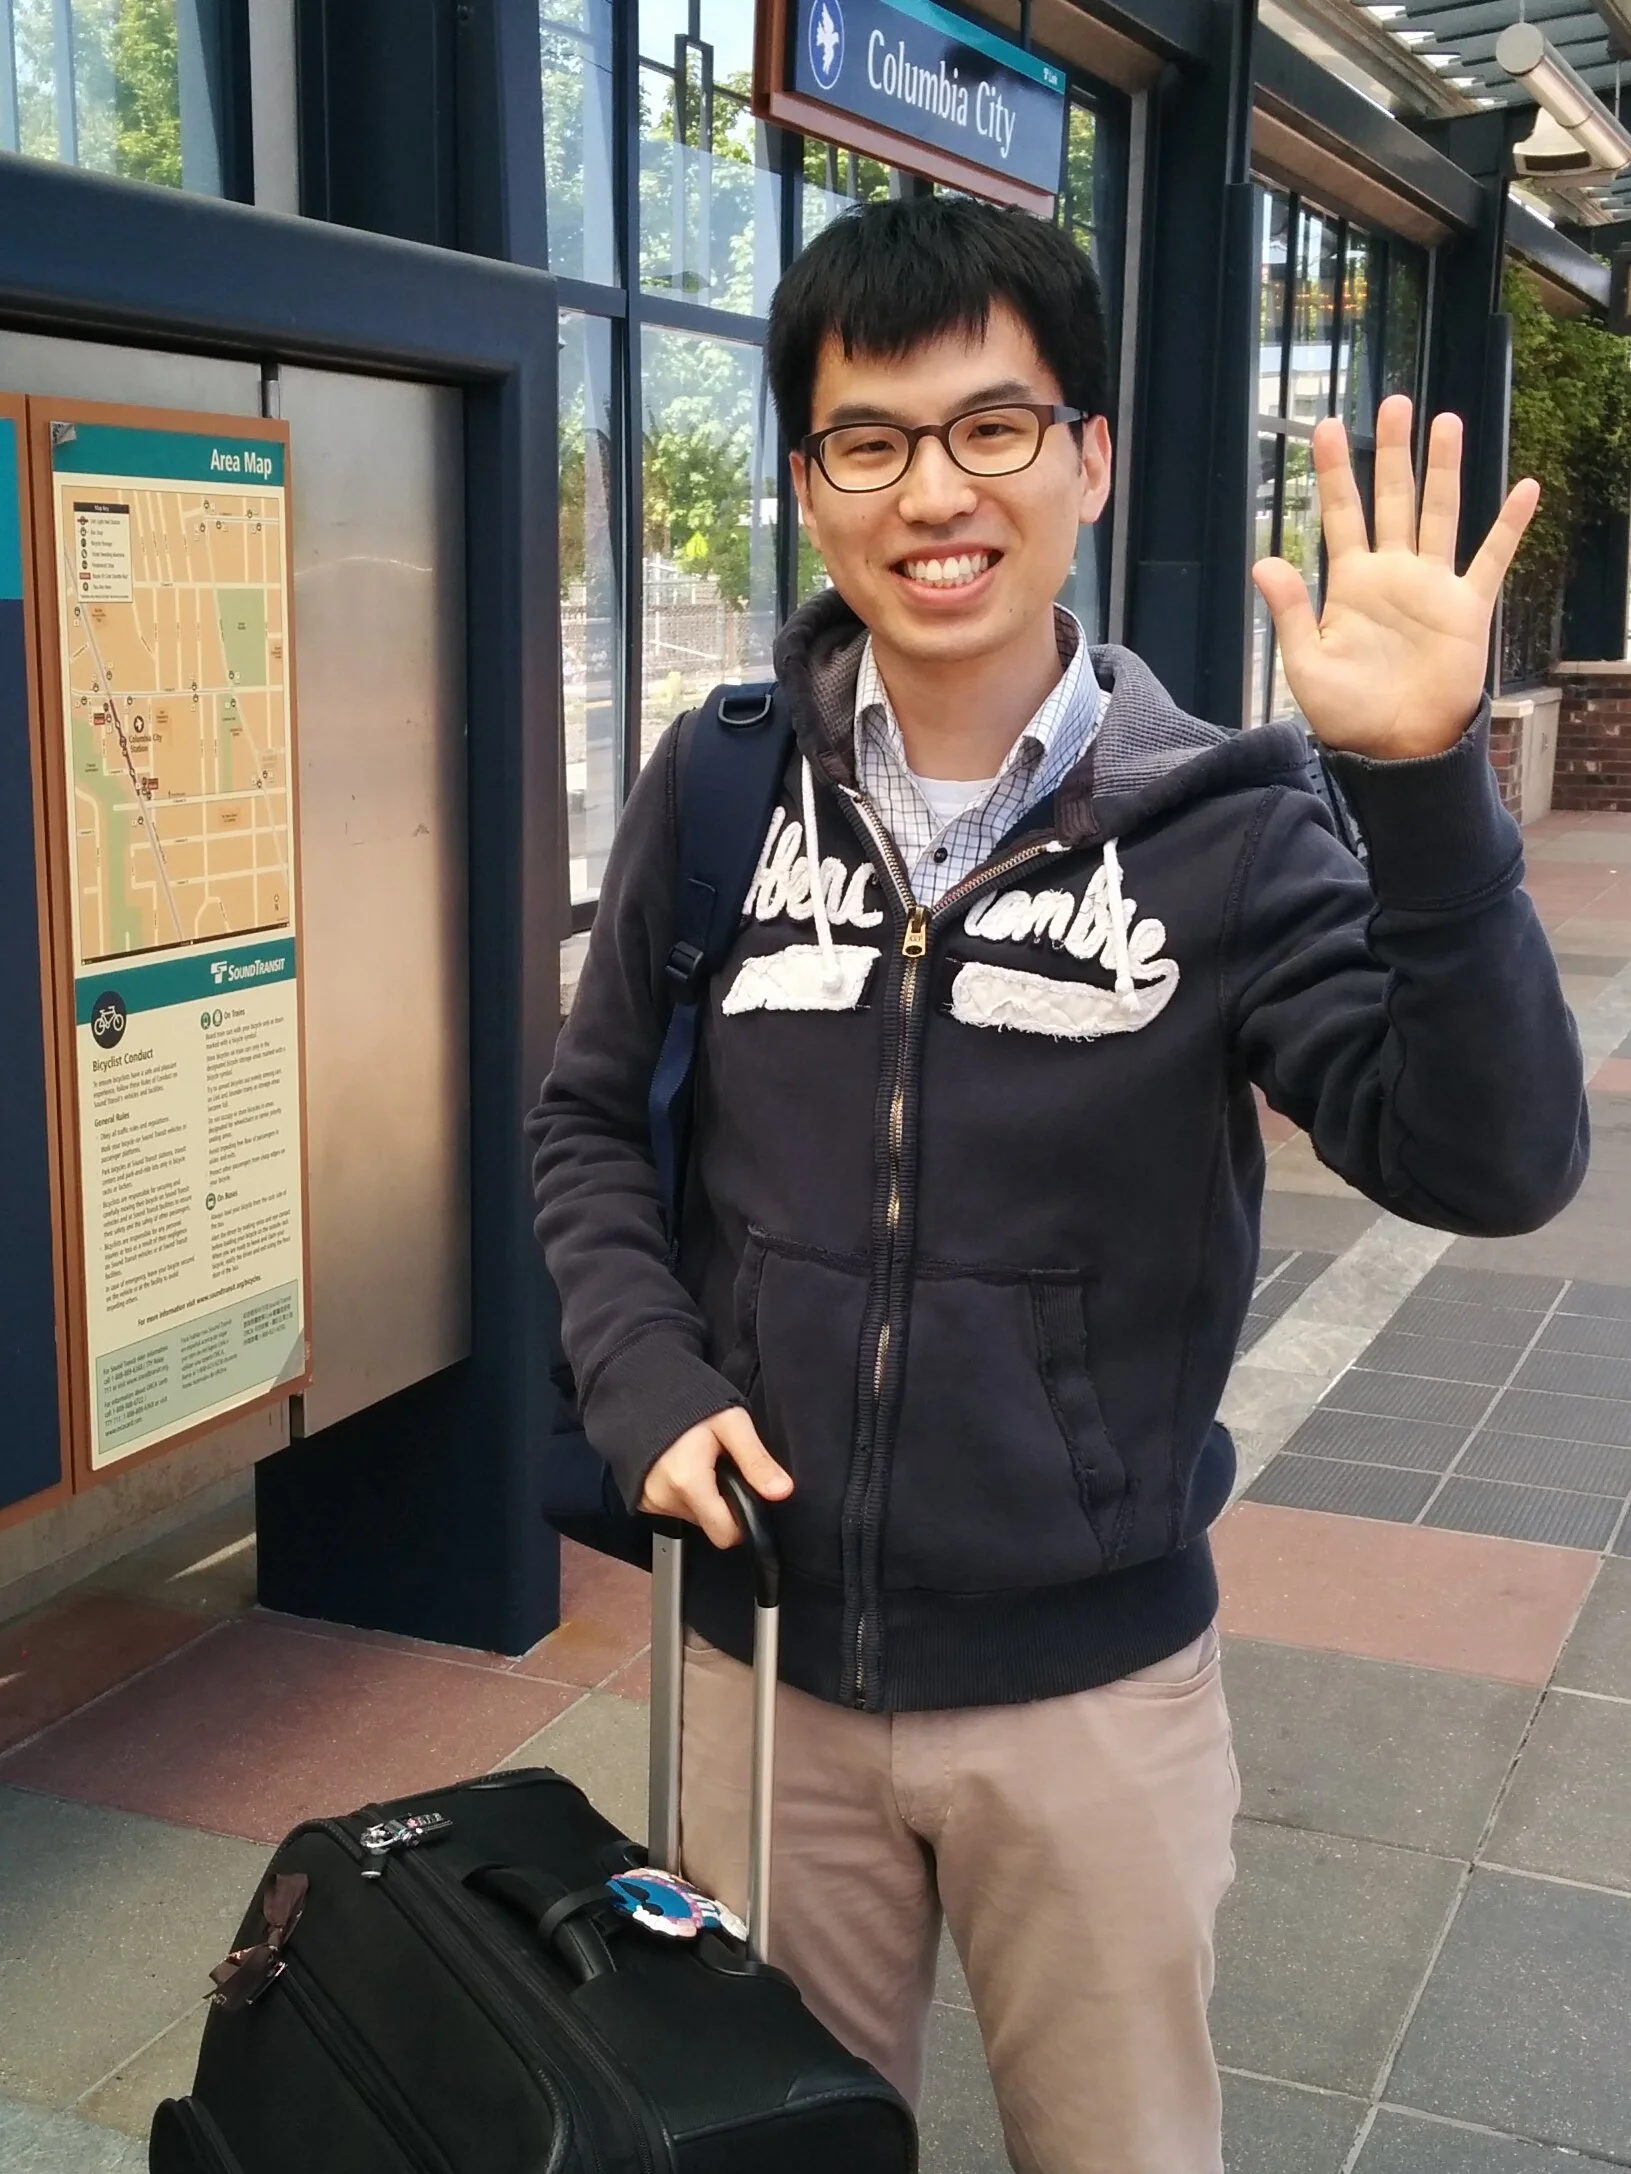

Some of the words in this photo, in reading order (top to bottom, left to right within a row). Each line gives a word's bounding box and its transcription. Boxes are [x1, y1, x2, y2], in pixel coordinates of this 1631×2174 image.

[868, 29, 968, 126] Columbia
[976, 81, 1016, 159] City
[210, 448, 240, 472] Area
[244, 451, 272, 480] Map
[232, 1008, 245, 1017] Trains
[92, 1056, 122, 1073] Bicyclist
[124, 1048, 153, 1064] Conduct
[94, 1114, 114, 1127] General
[115, 1110, 129, 1121] Rules
